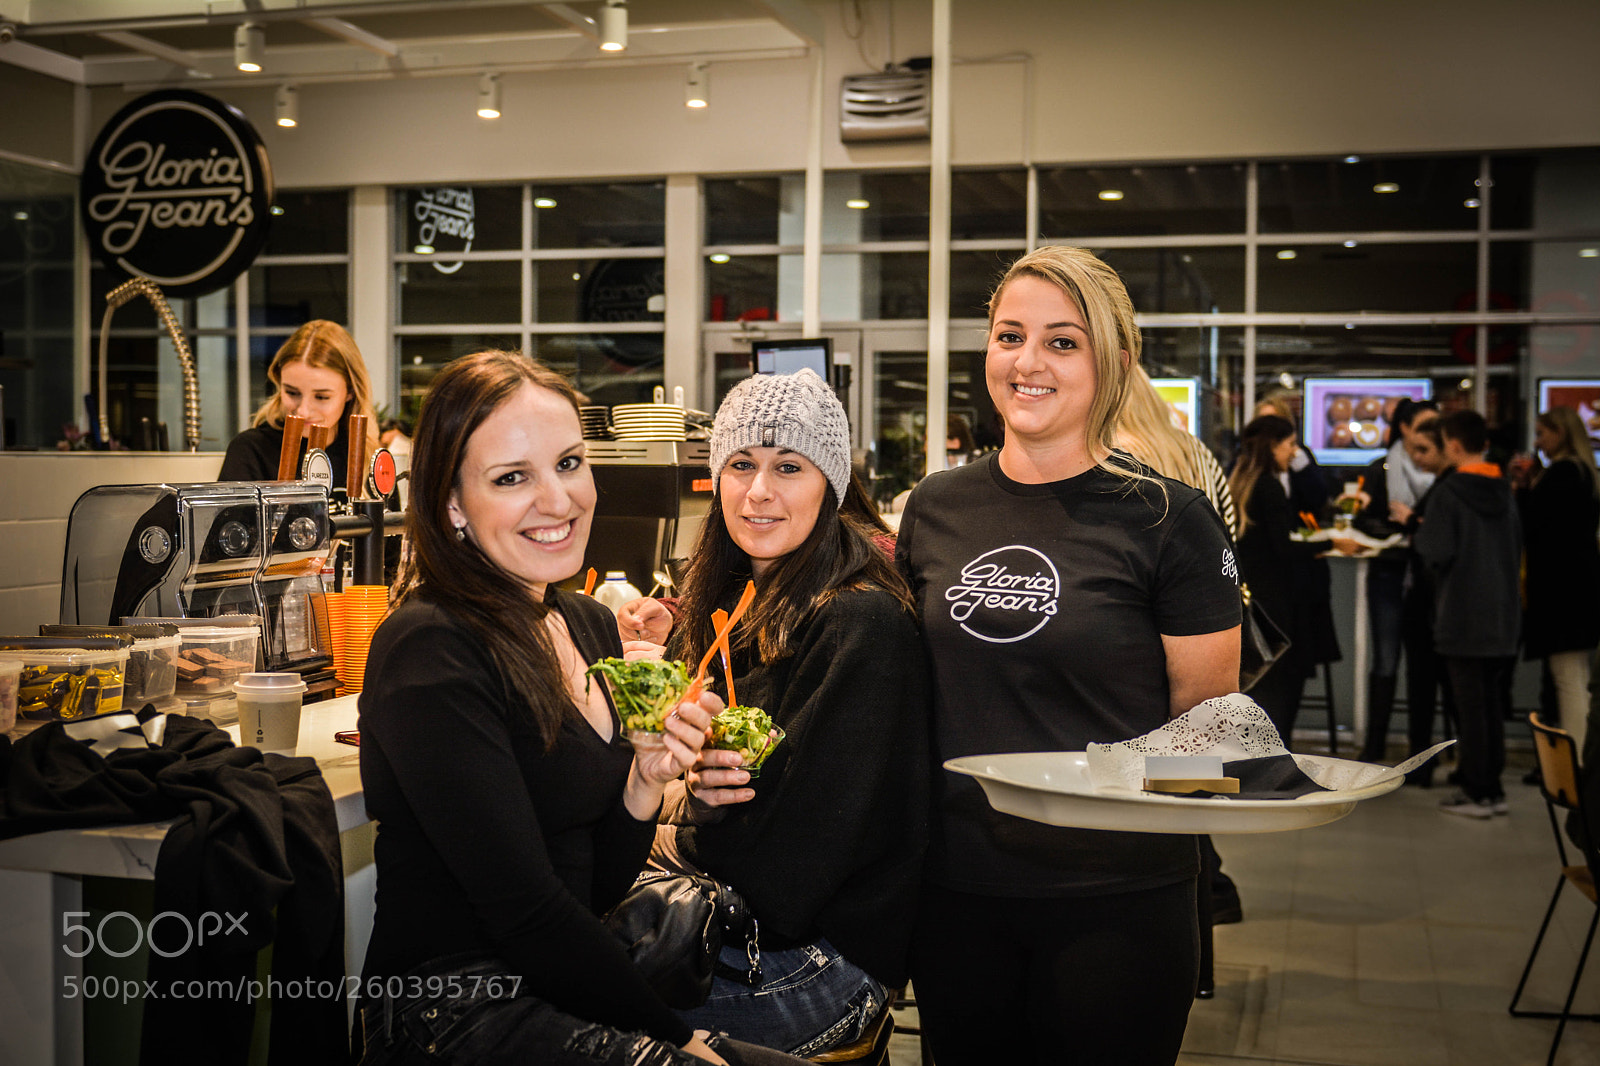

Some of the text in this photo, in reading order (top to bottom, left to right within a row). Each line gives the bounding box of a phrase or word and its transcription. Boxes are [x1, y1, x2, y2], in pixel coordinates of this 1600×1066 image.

[88, 140, 244, 222] Gloria
[102, 187, 254, 254] Jean's
[944, 563, 1054, 601] Gloria
[950, 592, 1058, 621] Jean's
